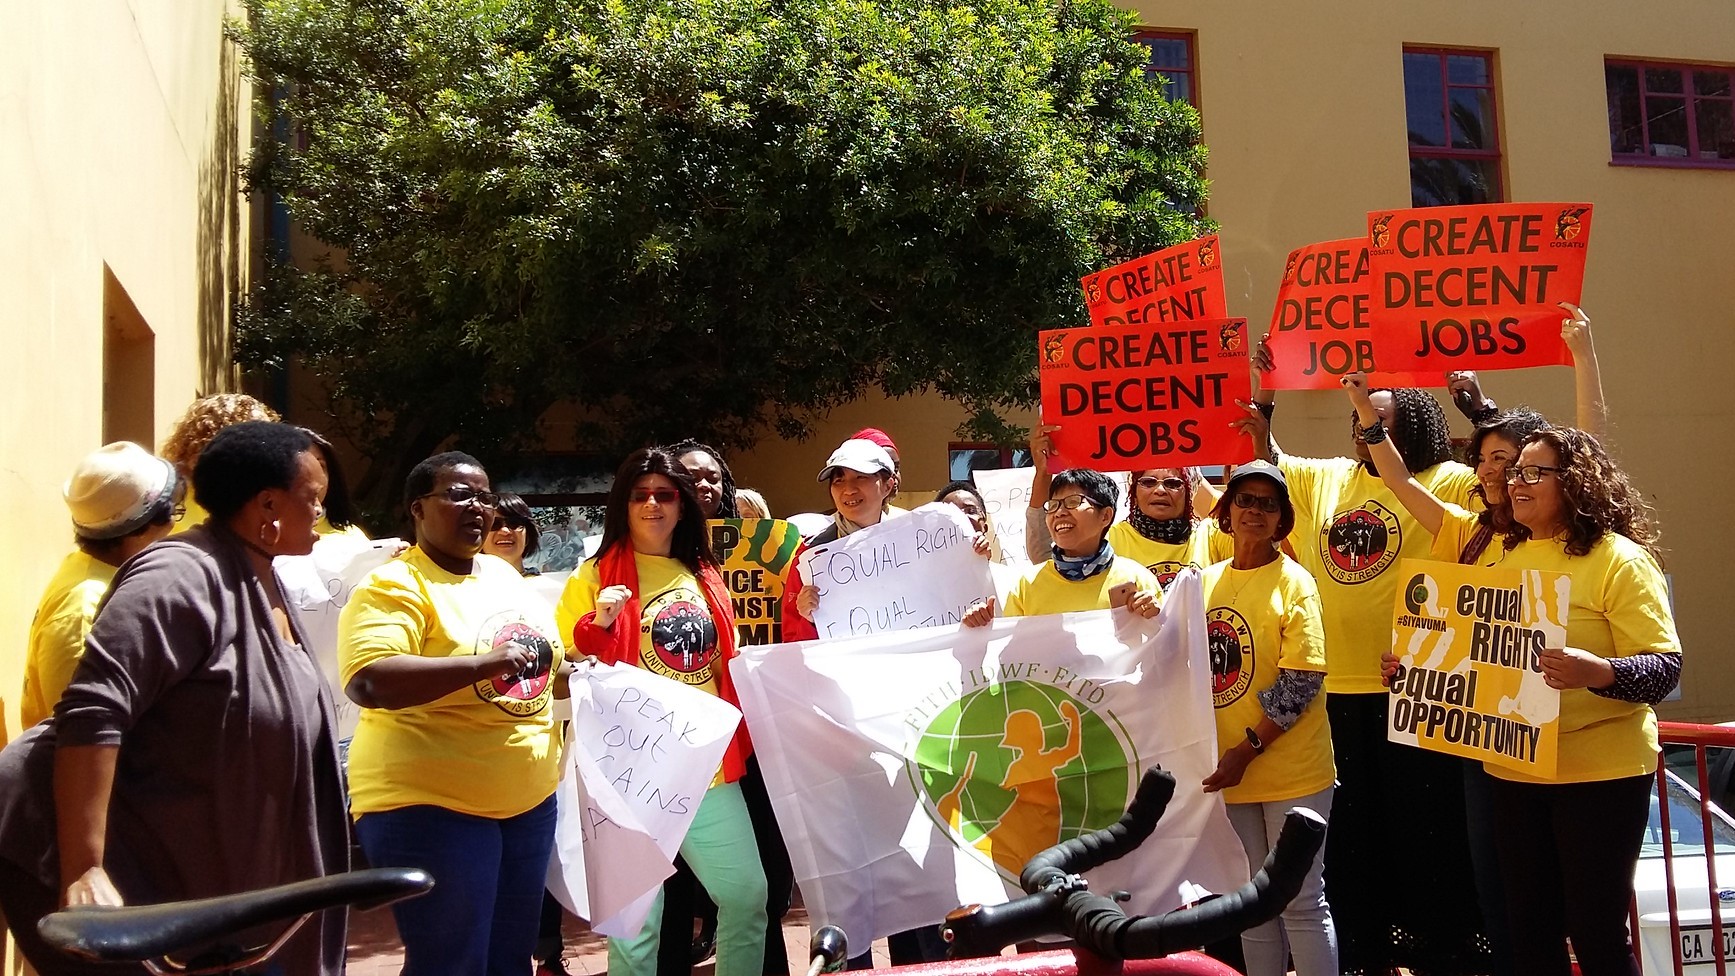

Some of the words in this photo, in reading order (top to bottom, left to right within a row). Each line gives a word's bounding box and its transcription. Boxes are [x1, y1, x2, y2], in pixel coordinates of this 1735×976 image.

[1397, 214, 1543, 258] CREATE
[1549, 241, 1585, 249] COSATU
[1105, 252, 1193, 304] CREATE
[1296, 247, 1369, 287] CREA
[1384, 264, 1557, 309] DECENT
[1278, 294, 1369, 331] DECE
[1072, 329, 1209, 371] CREATE
[1217, 349, 1246, 358] COSATU
[1415, 317, 1527, 358] JOBS
[1303, 340, 1374, 376] JOB
[1059, 373, 1228, 416] DECENT
[1090, 419, 1202, 460] JOBS
[983, 487, 1031, 514] SPE
[808, 543, 910, 597] EQUAL
[1337, 571, 1346, 580] IS
[1347, 550, 1395, 581] STRENGTH
[1396, 615, 1447, 632] #SIYAVUMA
[1456, 584, 1523, 624] equal
[644, 650, 671, 676] UNITY
[670, 672, 680, 681] IS
[1470, 622, 1546, 674] RIGHTS
[1052, 666, 1105, 704] FITD
[1390, 663, 1478, 708] equal
[511, 703, 522, 712] IS
[1394, 698, 1541, 763] OPPORTUNITY
[1682, 934, 1703, 959] CA
